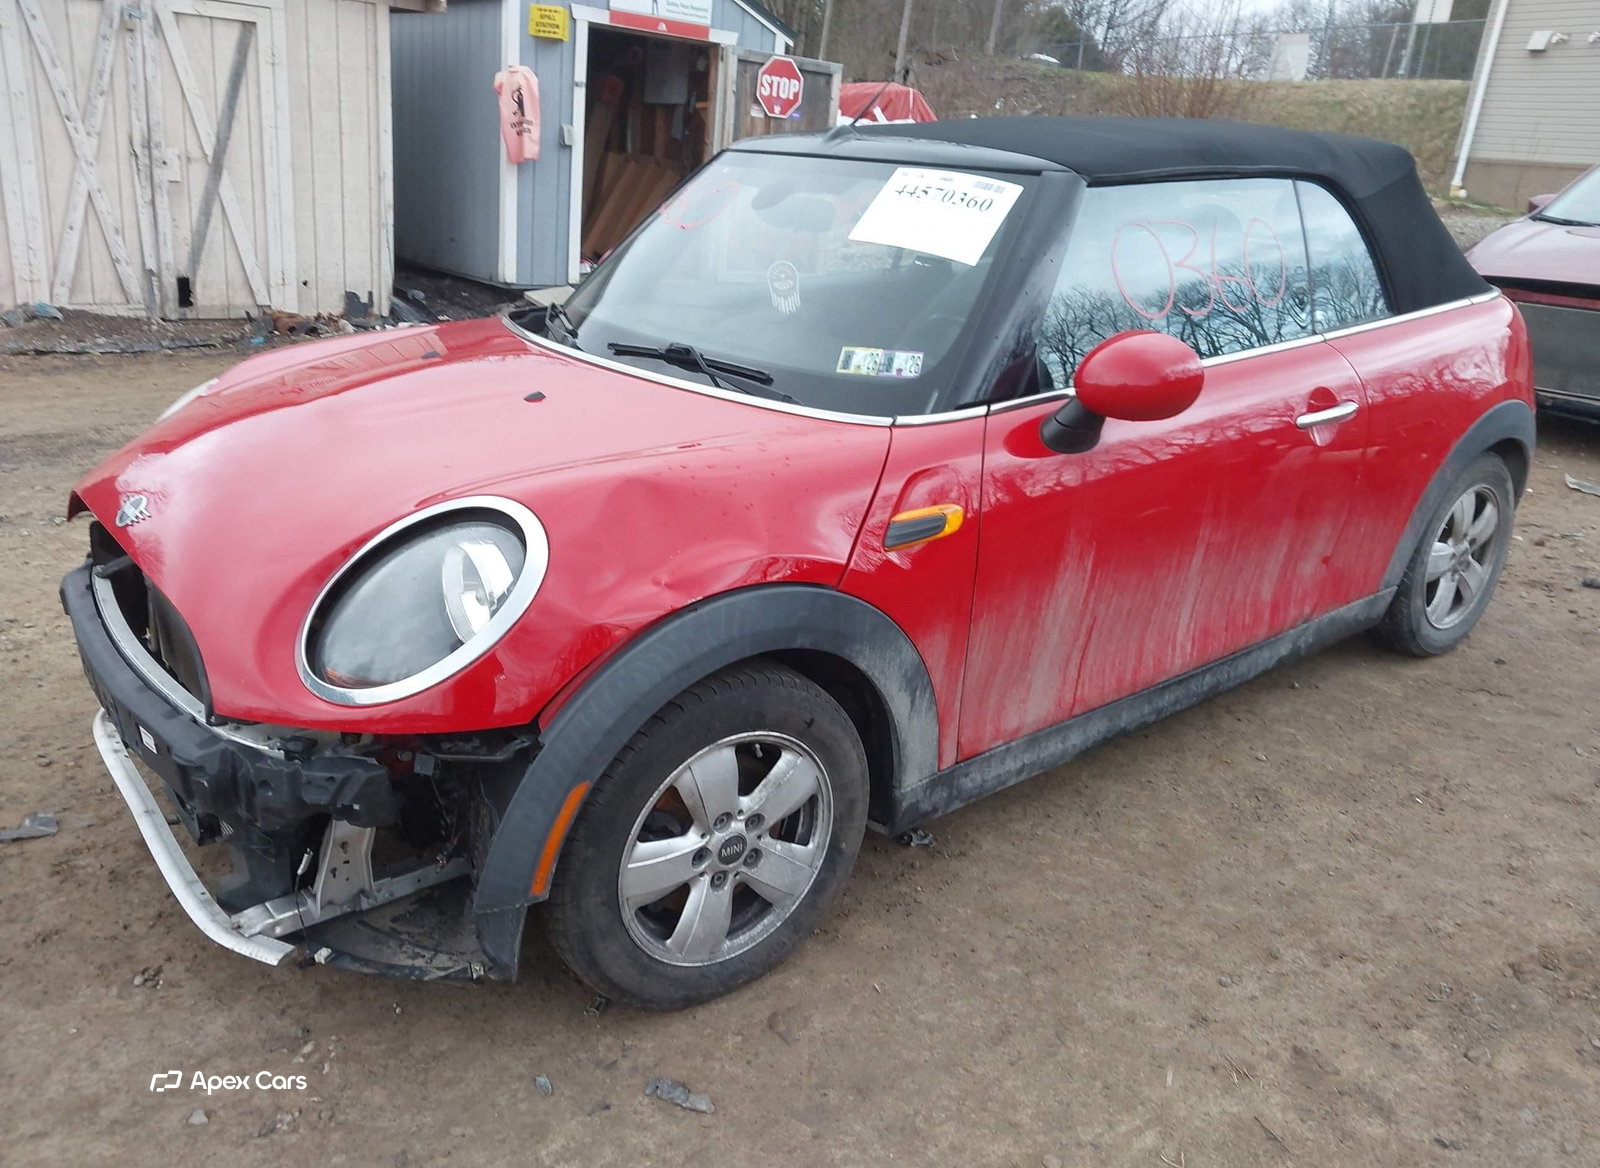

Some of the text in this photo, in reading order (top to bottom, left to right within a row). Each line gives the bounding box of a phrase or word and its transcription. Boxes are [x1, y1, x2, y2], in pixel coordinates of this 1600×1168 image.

[535, 21, 560, 30] STATION
[760, 73, 800, 100] STOP
[895, 183, 994, 212] 44570360
[1111, 218, 1286, 319] 0360
[721, 843, 743, 858] MINI
